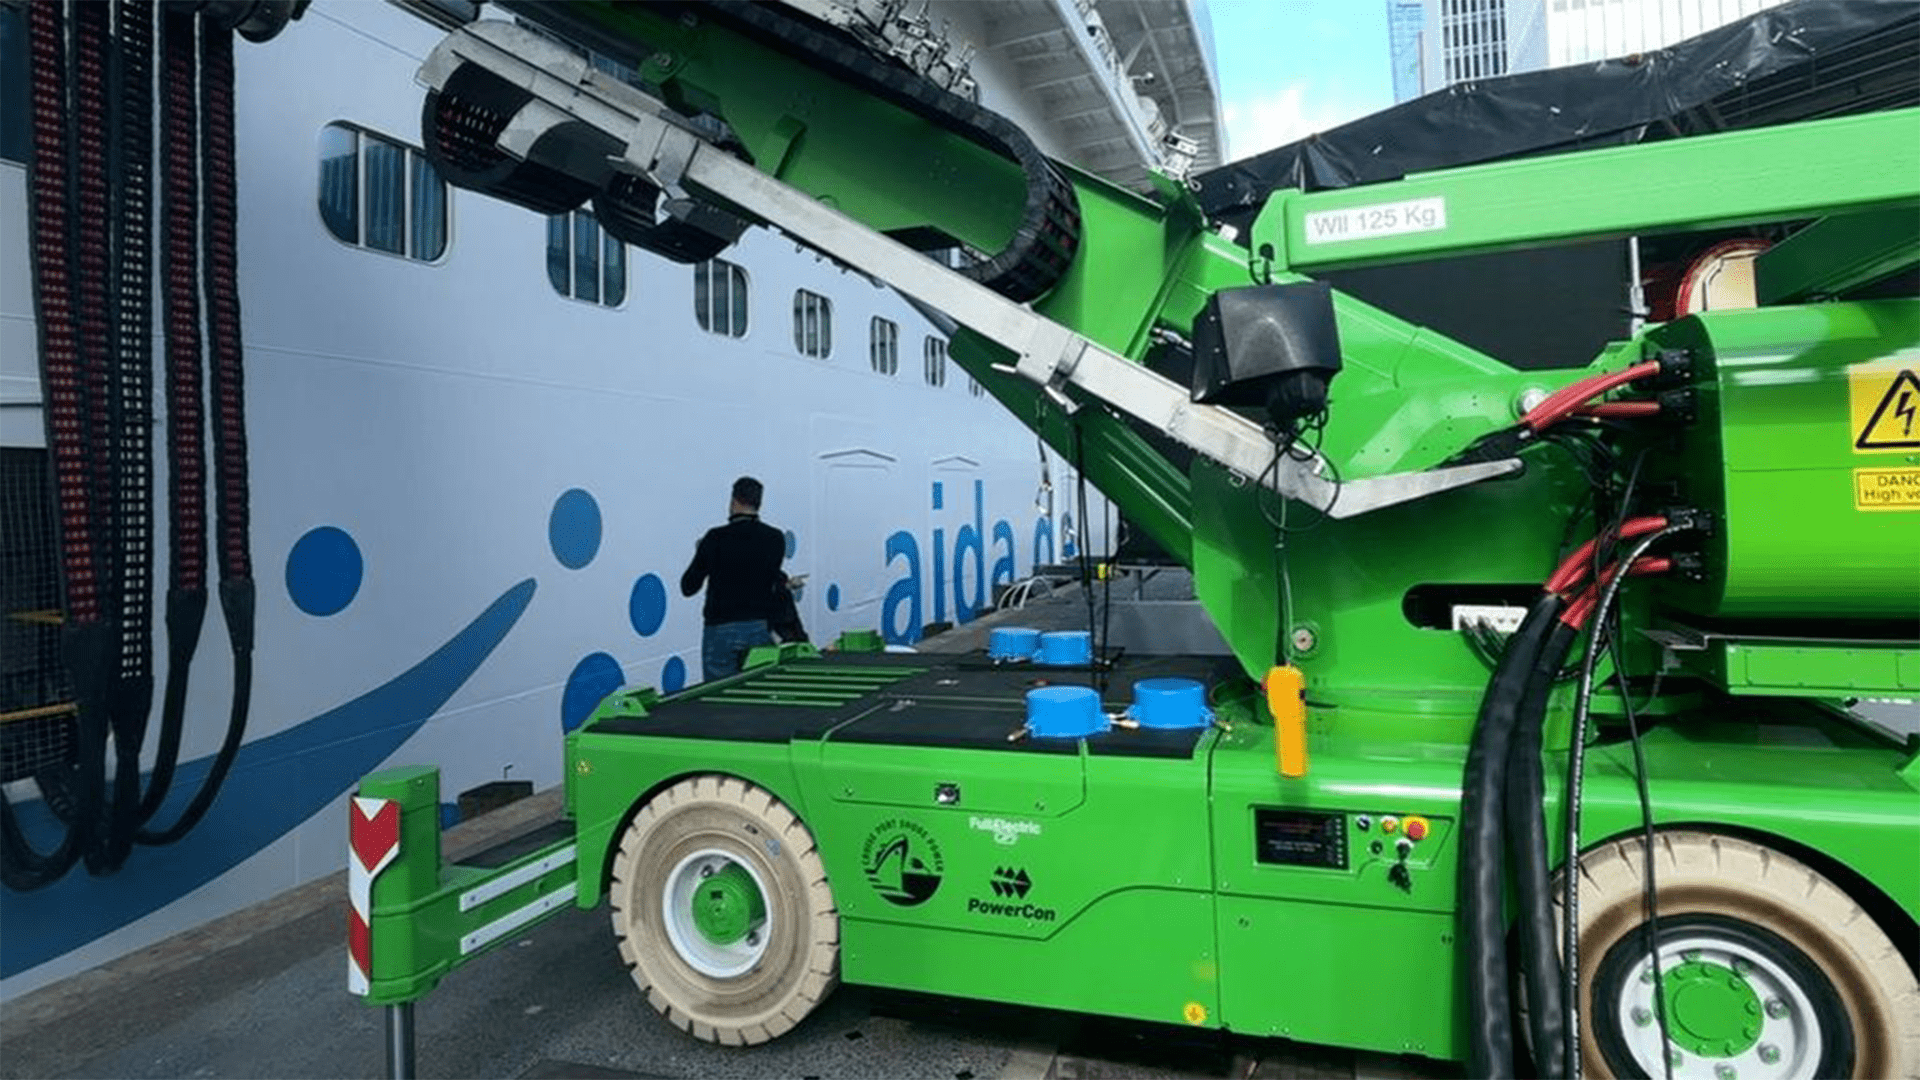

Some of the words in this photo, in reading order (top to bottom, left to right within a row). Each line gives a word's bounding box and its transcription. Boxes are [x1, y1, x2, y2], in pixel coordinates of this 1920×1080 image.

[1357, 208, 1398, 231] 125
[1404, 205, 1436, 227] Kg
[1864, 489, 1902, 503] High
[968, 898, 1055, 922] PowerCon
